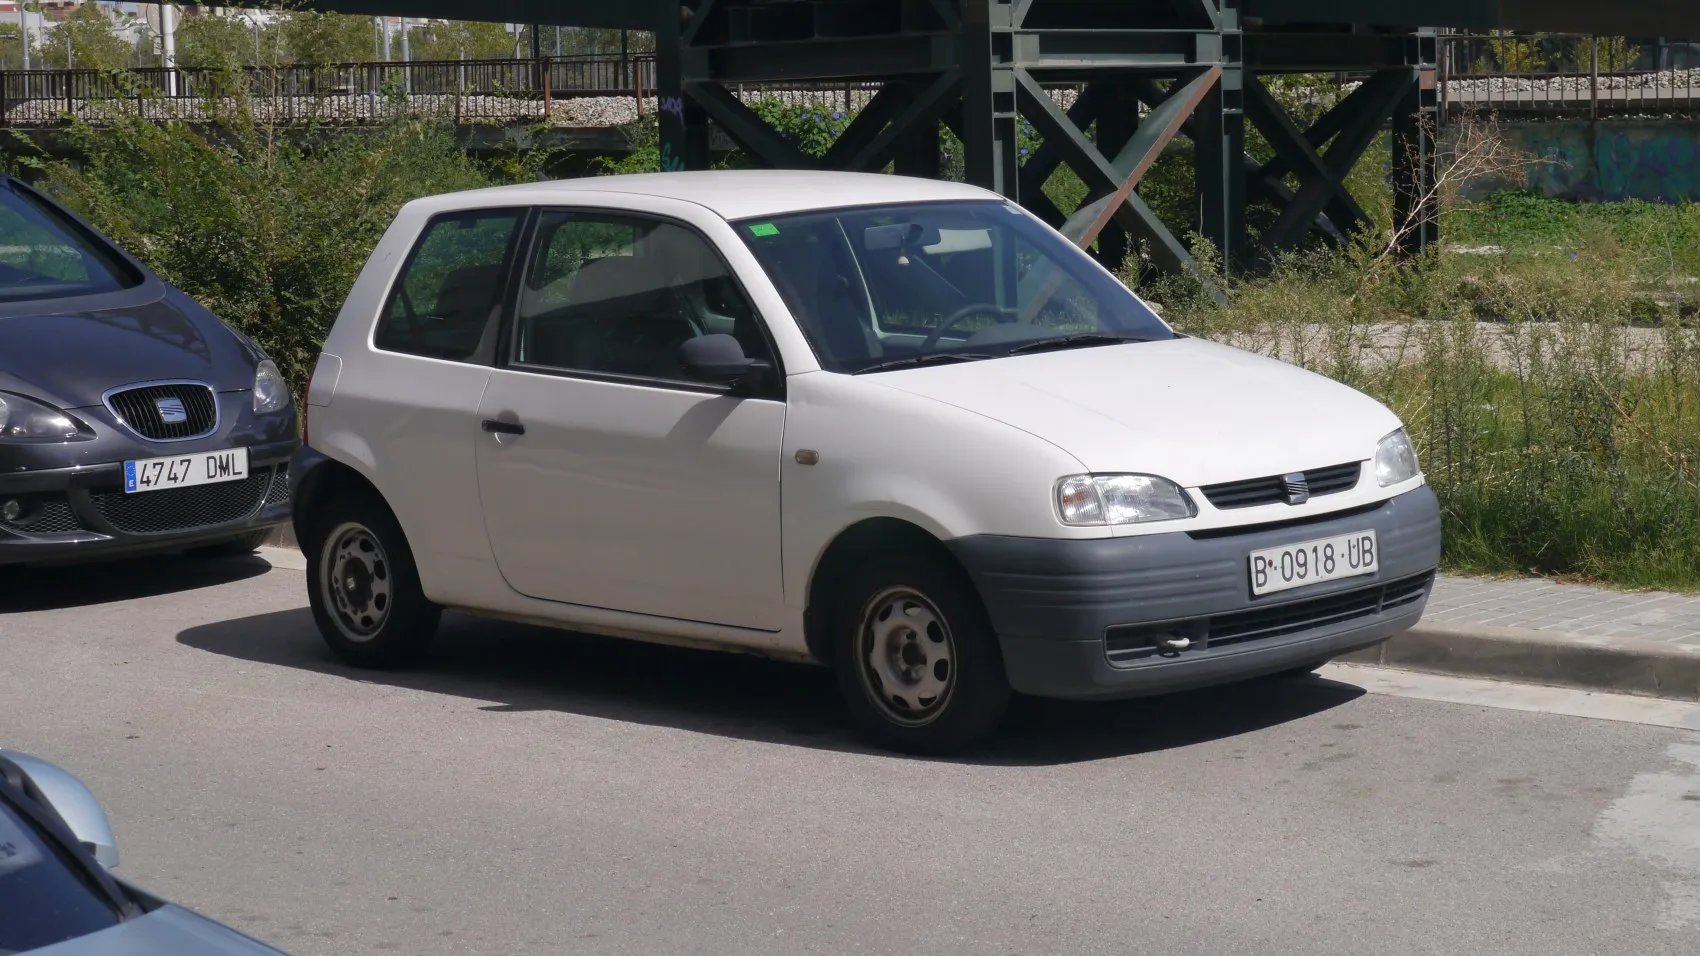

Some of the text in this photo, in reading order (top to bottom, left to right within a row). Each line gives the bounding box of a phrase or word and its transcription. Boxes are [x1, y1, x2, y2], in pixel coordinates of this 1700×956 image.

[139, 453, 243, 487] 4747 DML
[128, 479, 135, 488] E
